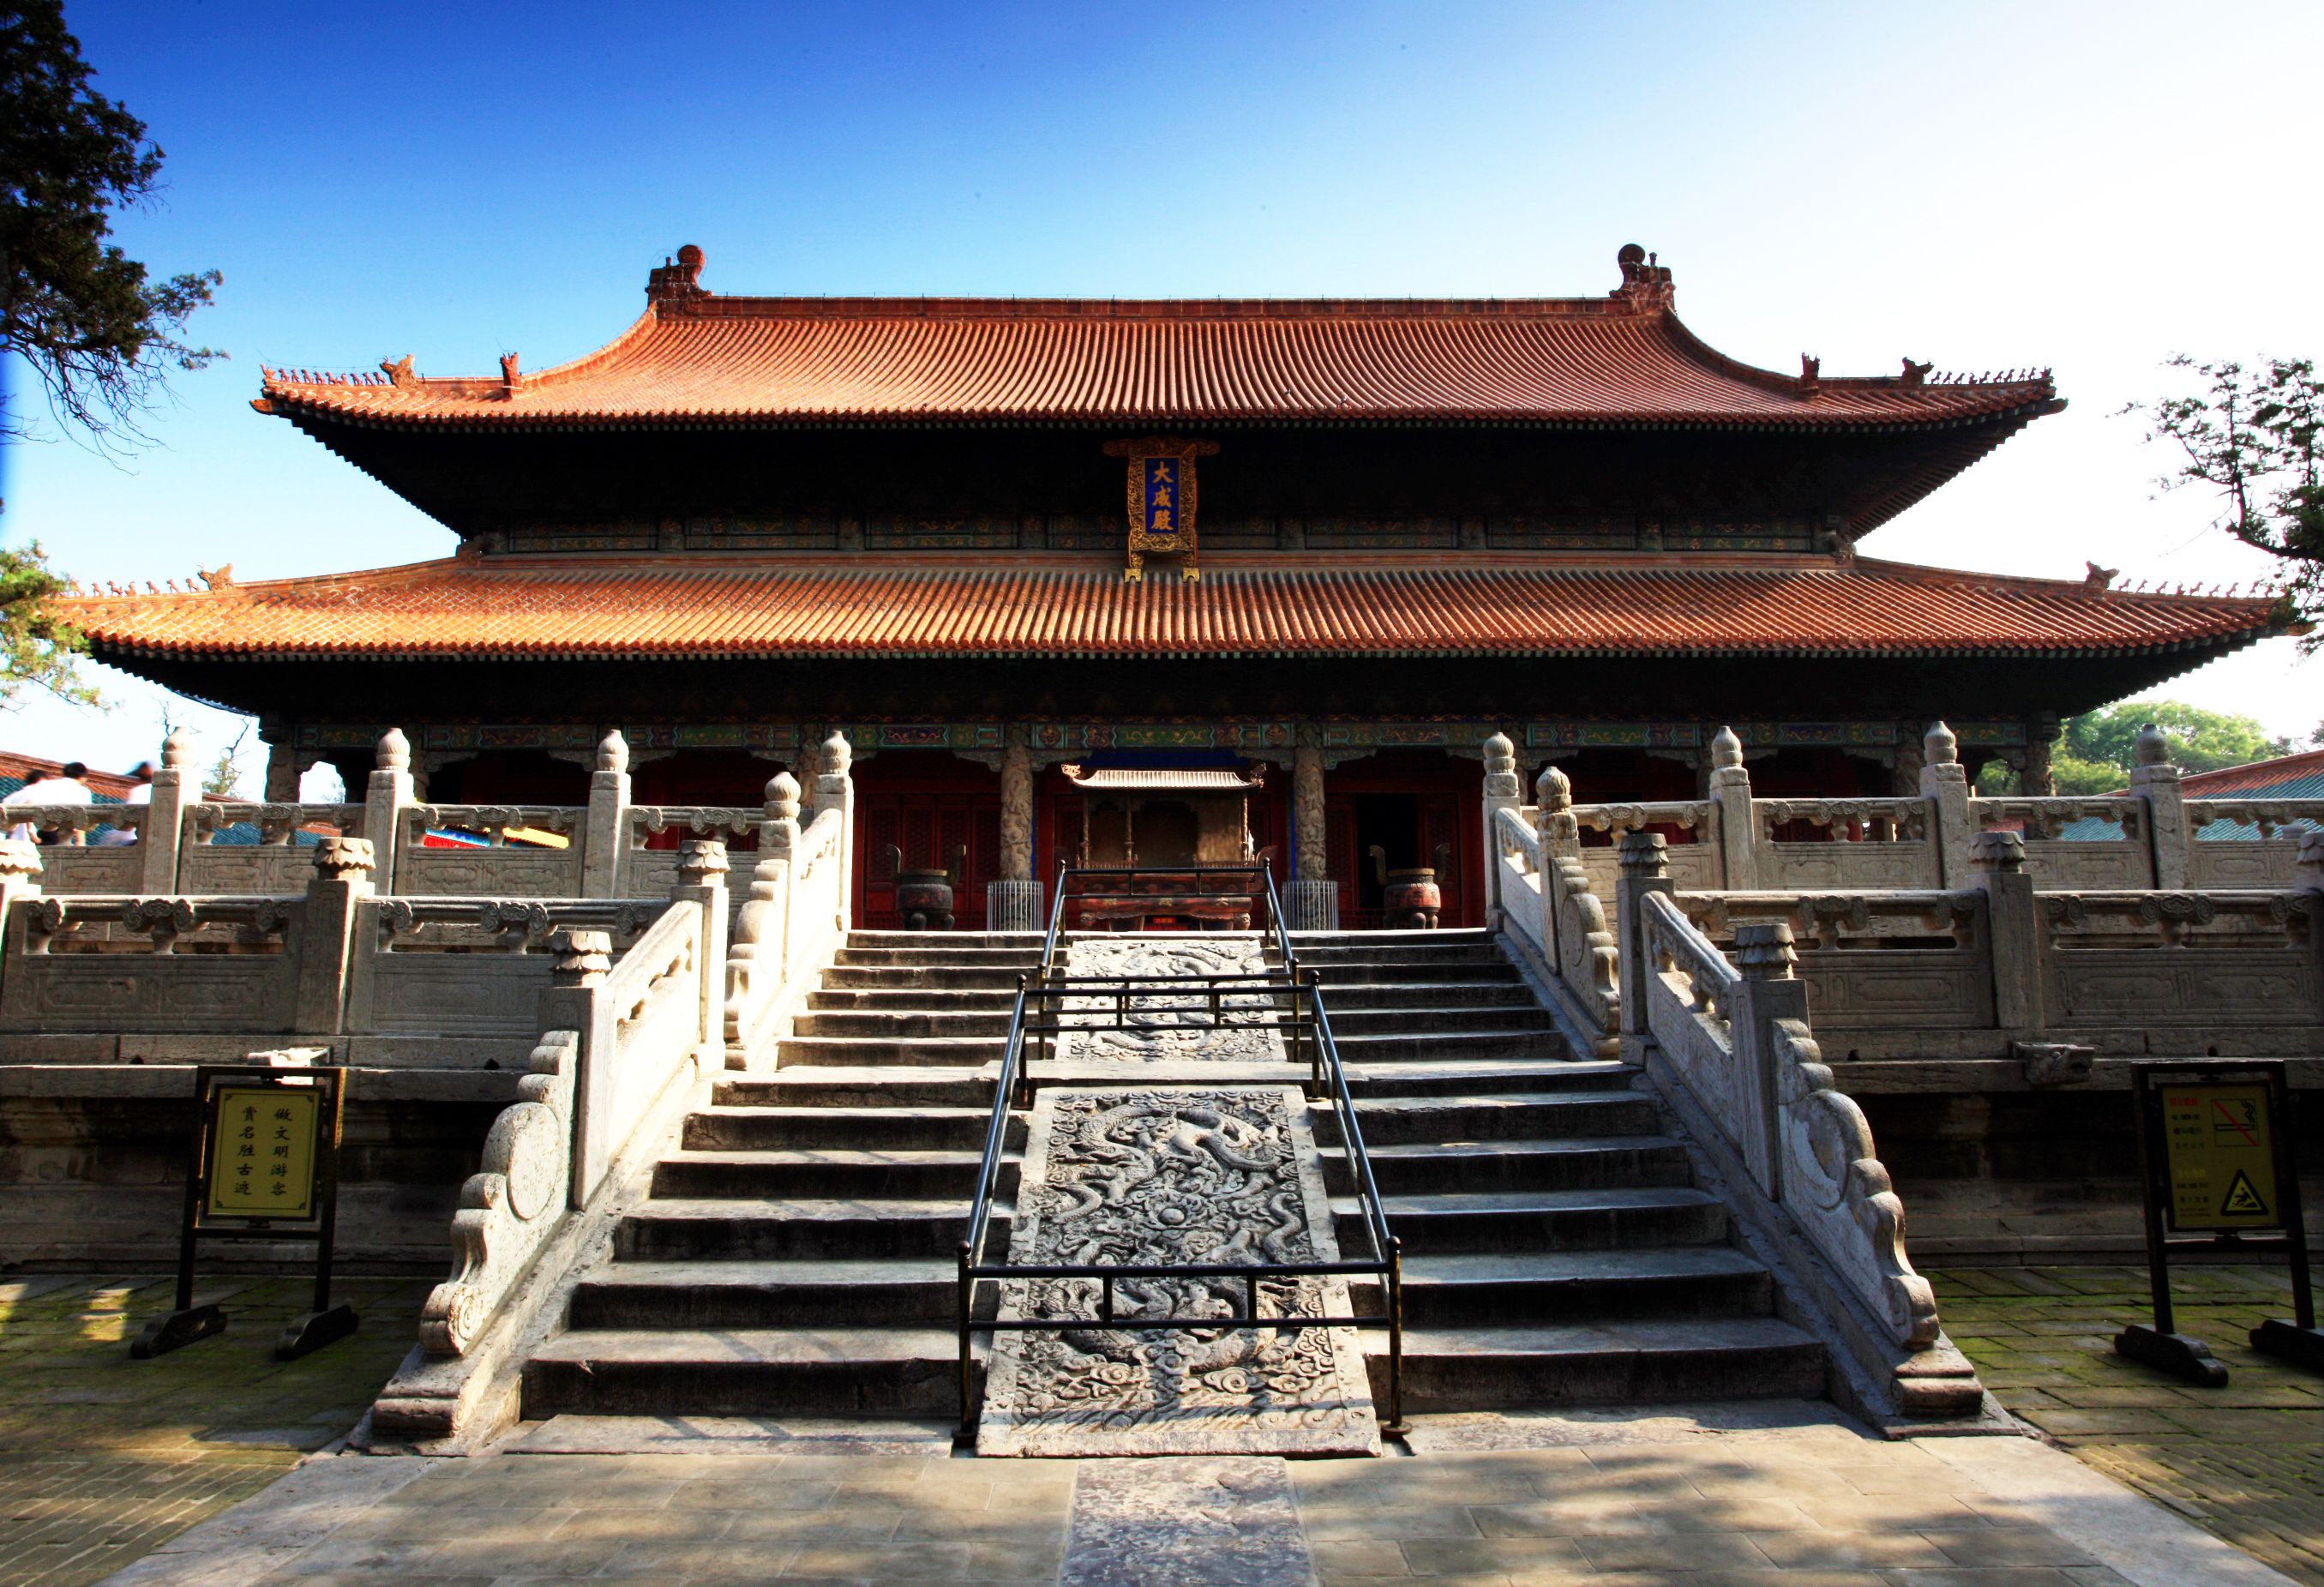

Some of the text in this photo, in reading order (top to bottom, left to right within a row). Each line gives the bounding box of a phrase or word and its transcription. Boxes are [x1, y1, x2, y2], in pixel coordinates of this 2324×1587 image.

[1151, 461, 1174, 531] 大成殿
[270, 1108, 293, 1196] 做文明游客
